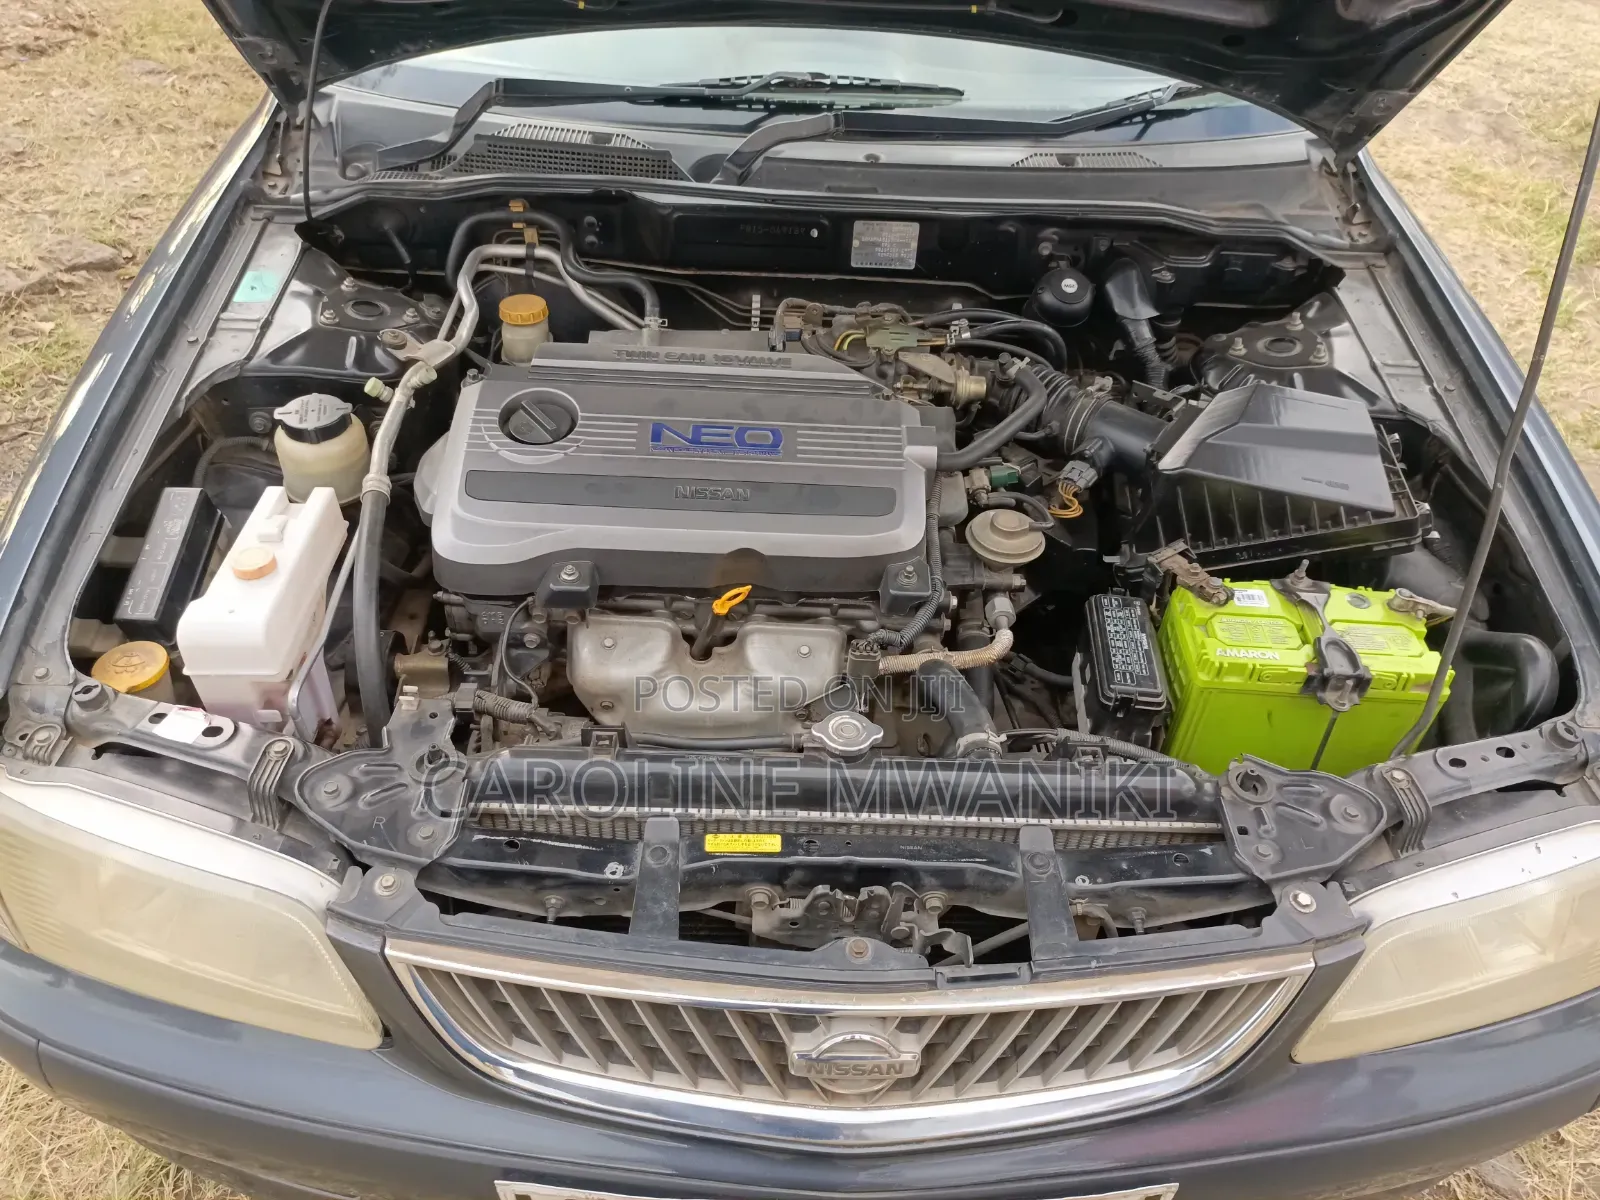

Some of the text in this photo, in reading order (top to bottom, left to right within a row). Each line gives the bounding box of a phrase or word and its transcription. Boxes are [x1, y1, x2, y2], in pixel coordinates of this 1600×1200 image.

[613, 349, 660, 361] TWIN
[664, 351, 706, 364] CAM
[651, 421, 783, 450] NEO
[673, 484, 750, 501] NISSAN
[1216, 648, 1280, 660] AMARON
[806, 1061, 905, 1077] NISSAN
